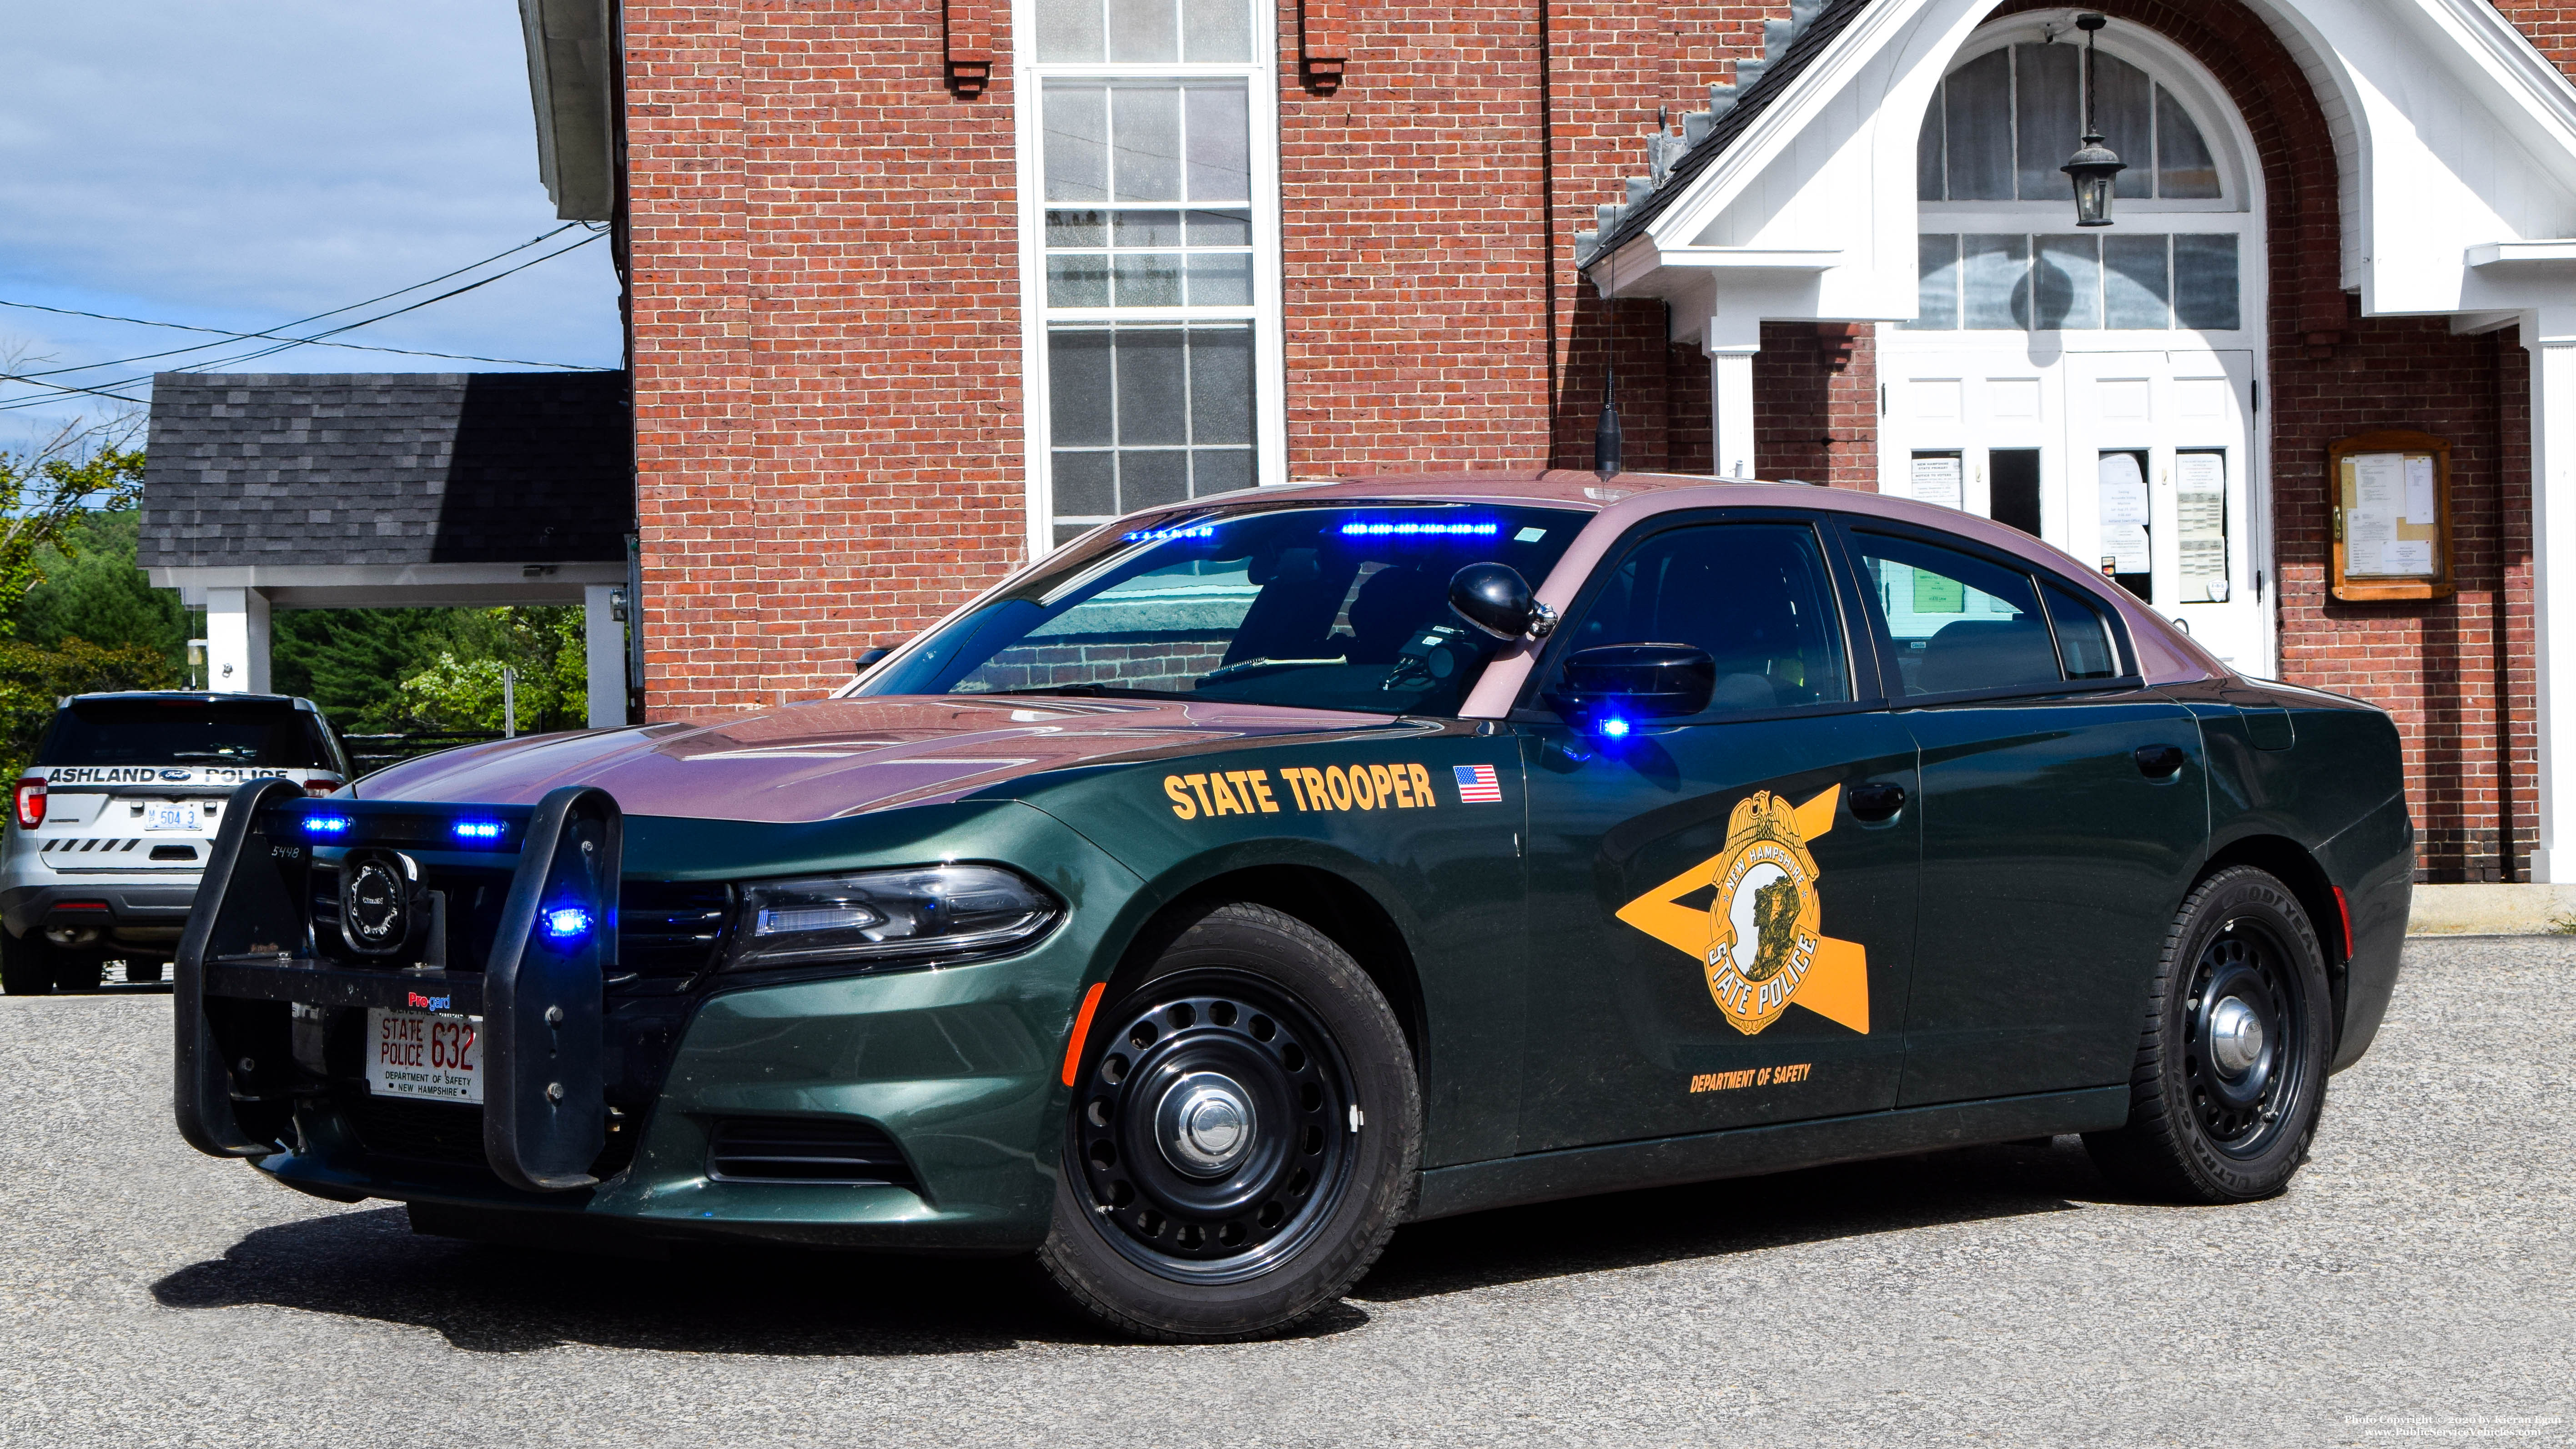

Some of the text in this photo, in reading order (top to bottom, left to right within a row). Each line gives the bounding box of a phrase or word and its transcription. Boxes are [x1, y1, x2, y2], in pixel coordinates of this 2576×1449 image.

[48, 769, 155, 783] ASHLAND
[1163, 763, 1436, 820] STATE TROOPER
[161, 811, 194, 824] 504 3
[272, 846, 299, 858] 5448
[1726, 845, 1805, 891] NEW HAMPSHIRE
[1708, 932, 1816, 1015] STATE POLICE
[409, 992, 450, 1011] Pro-gard
[382, 1018, 423, 1042] STATE
[381, 1042, 423, 1067] POLICE
[432, 1021, 474, 1071] 632
[386, 1071, 471, 1087] DEPARTMENT OF SAFETY
[398, 1083, 458, 1096] NEW HAMPSHIRE
[1690, 1063, 1811, 1092] DEPARTMENT OF SAFETY
